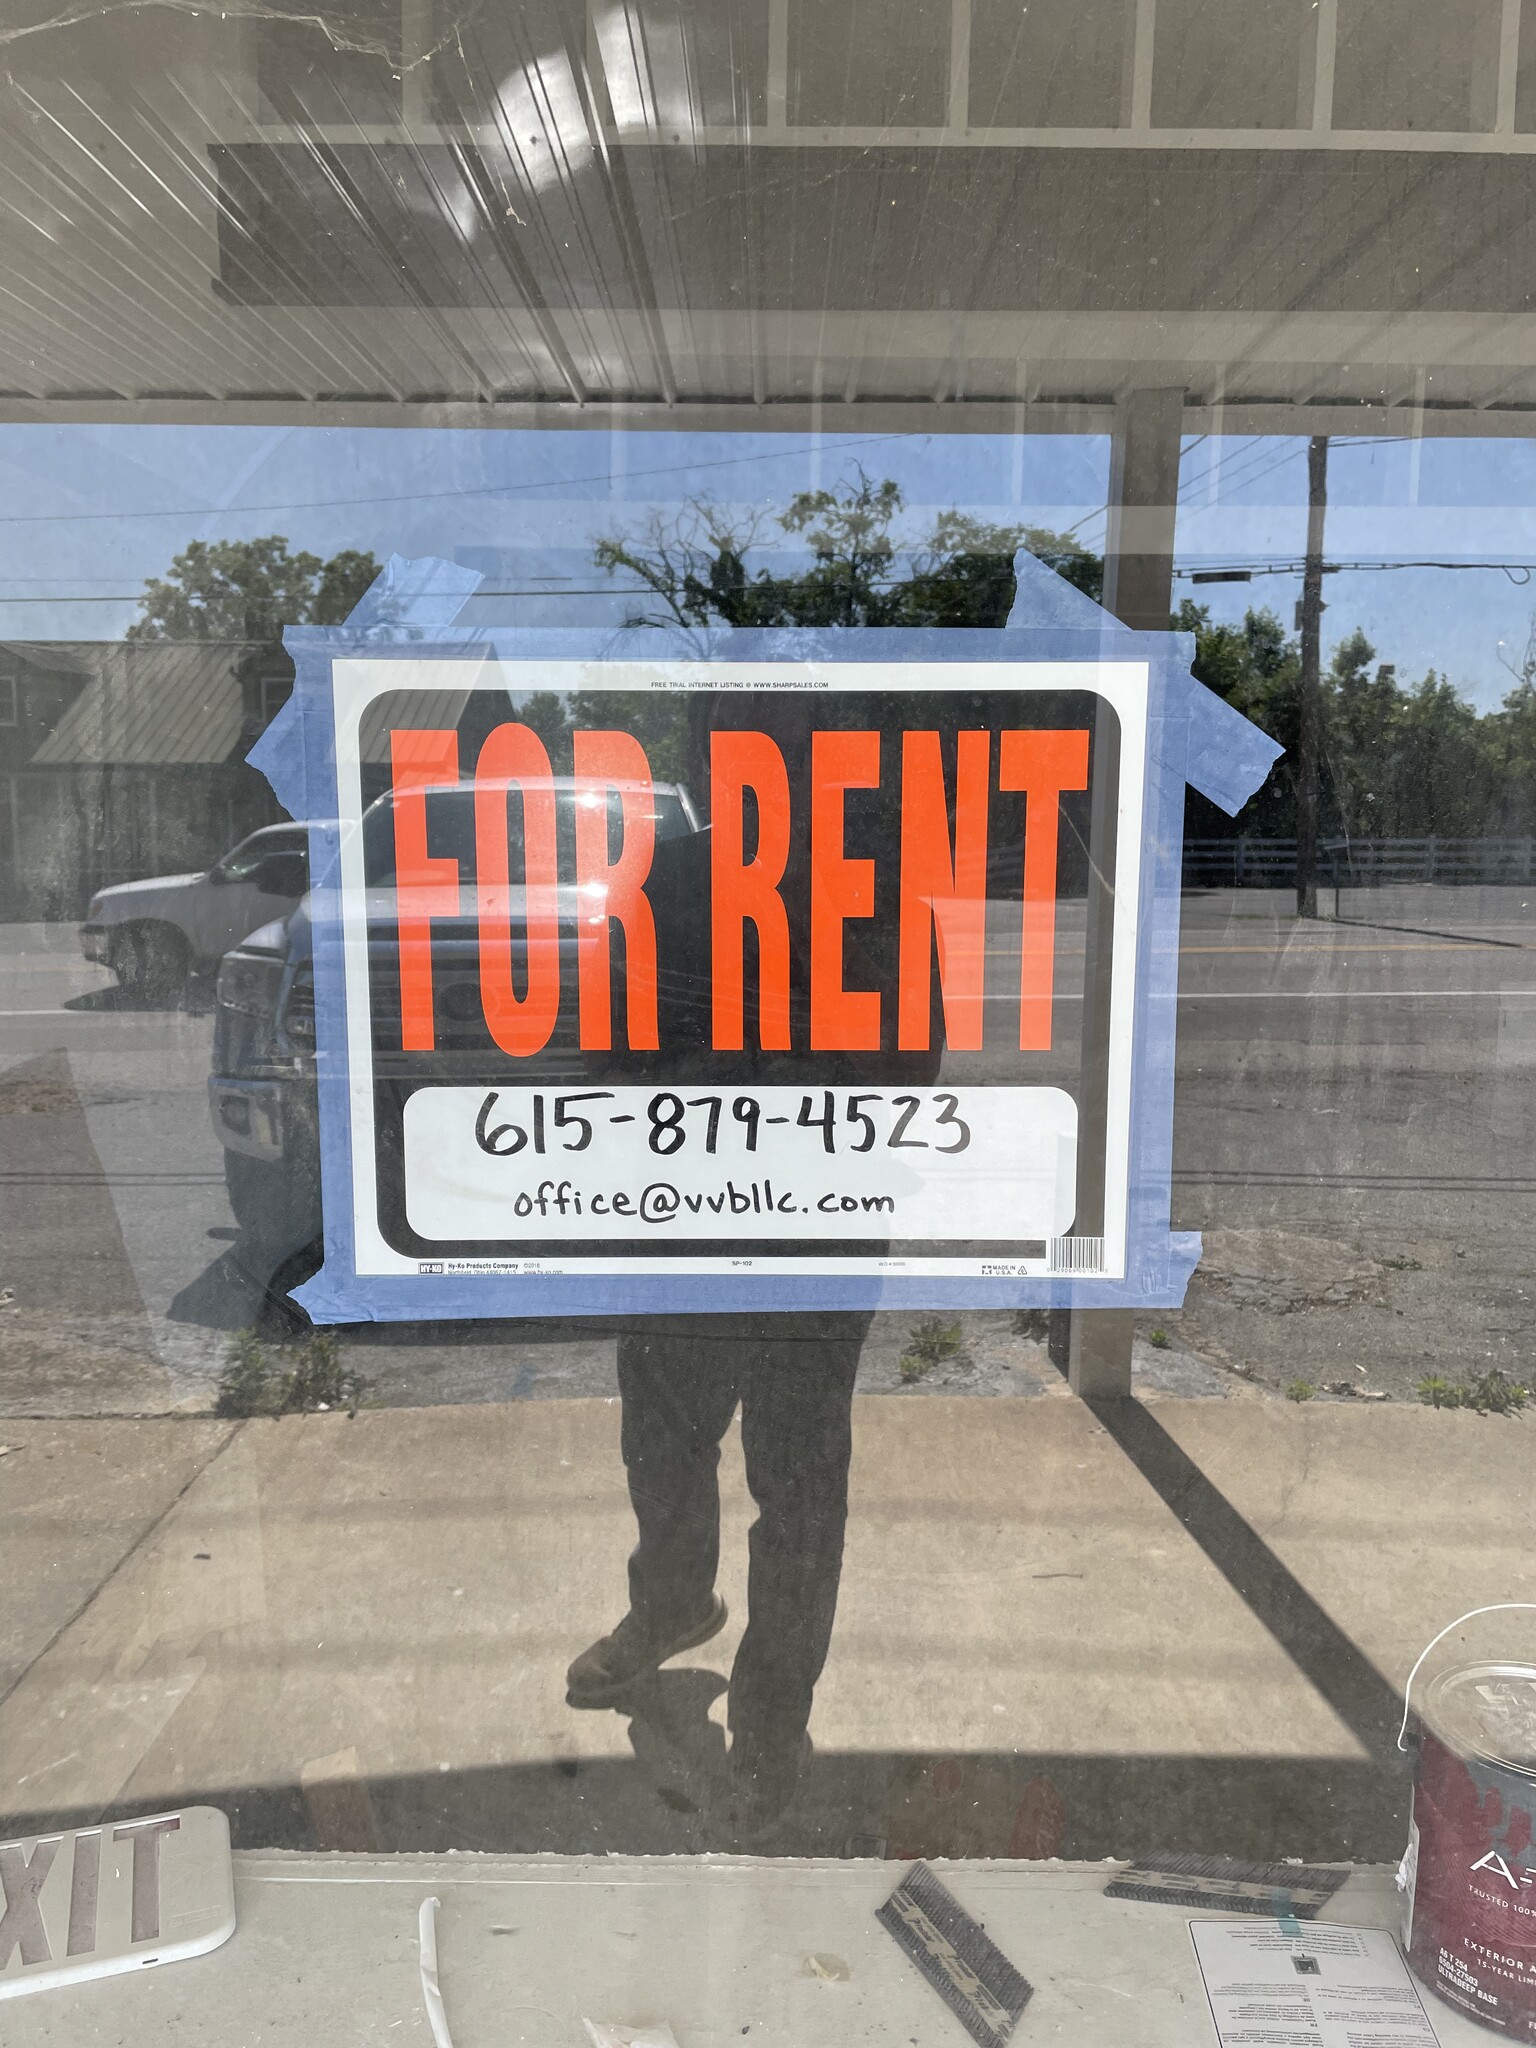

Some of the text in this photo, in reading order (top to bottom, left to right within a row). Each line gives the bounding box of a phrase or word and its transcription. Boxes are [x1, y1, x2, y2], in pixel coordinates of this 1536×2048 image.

[390, 722, 1090, 1058] FOR RENT
[474, 1089, 971, 1156] 615-879-4523
[420, 1264, 442, 1273] HY-KO
[1469, 1884, 1536, 1917] TRUSTED 100%
[1454, 1959, 1468, 1972] 254
[1464, 1938, 1524, 1970] EXTERIOR
[1477, 1959, 1514, 1980] 15-YEAR
[1437, 1964, 1476, 1994] ULTRADEEP
[1477, 1989, 1498, 2006] BASE
[1438, 1956, 1479, 1987] 6504-27503
